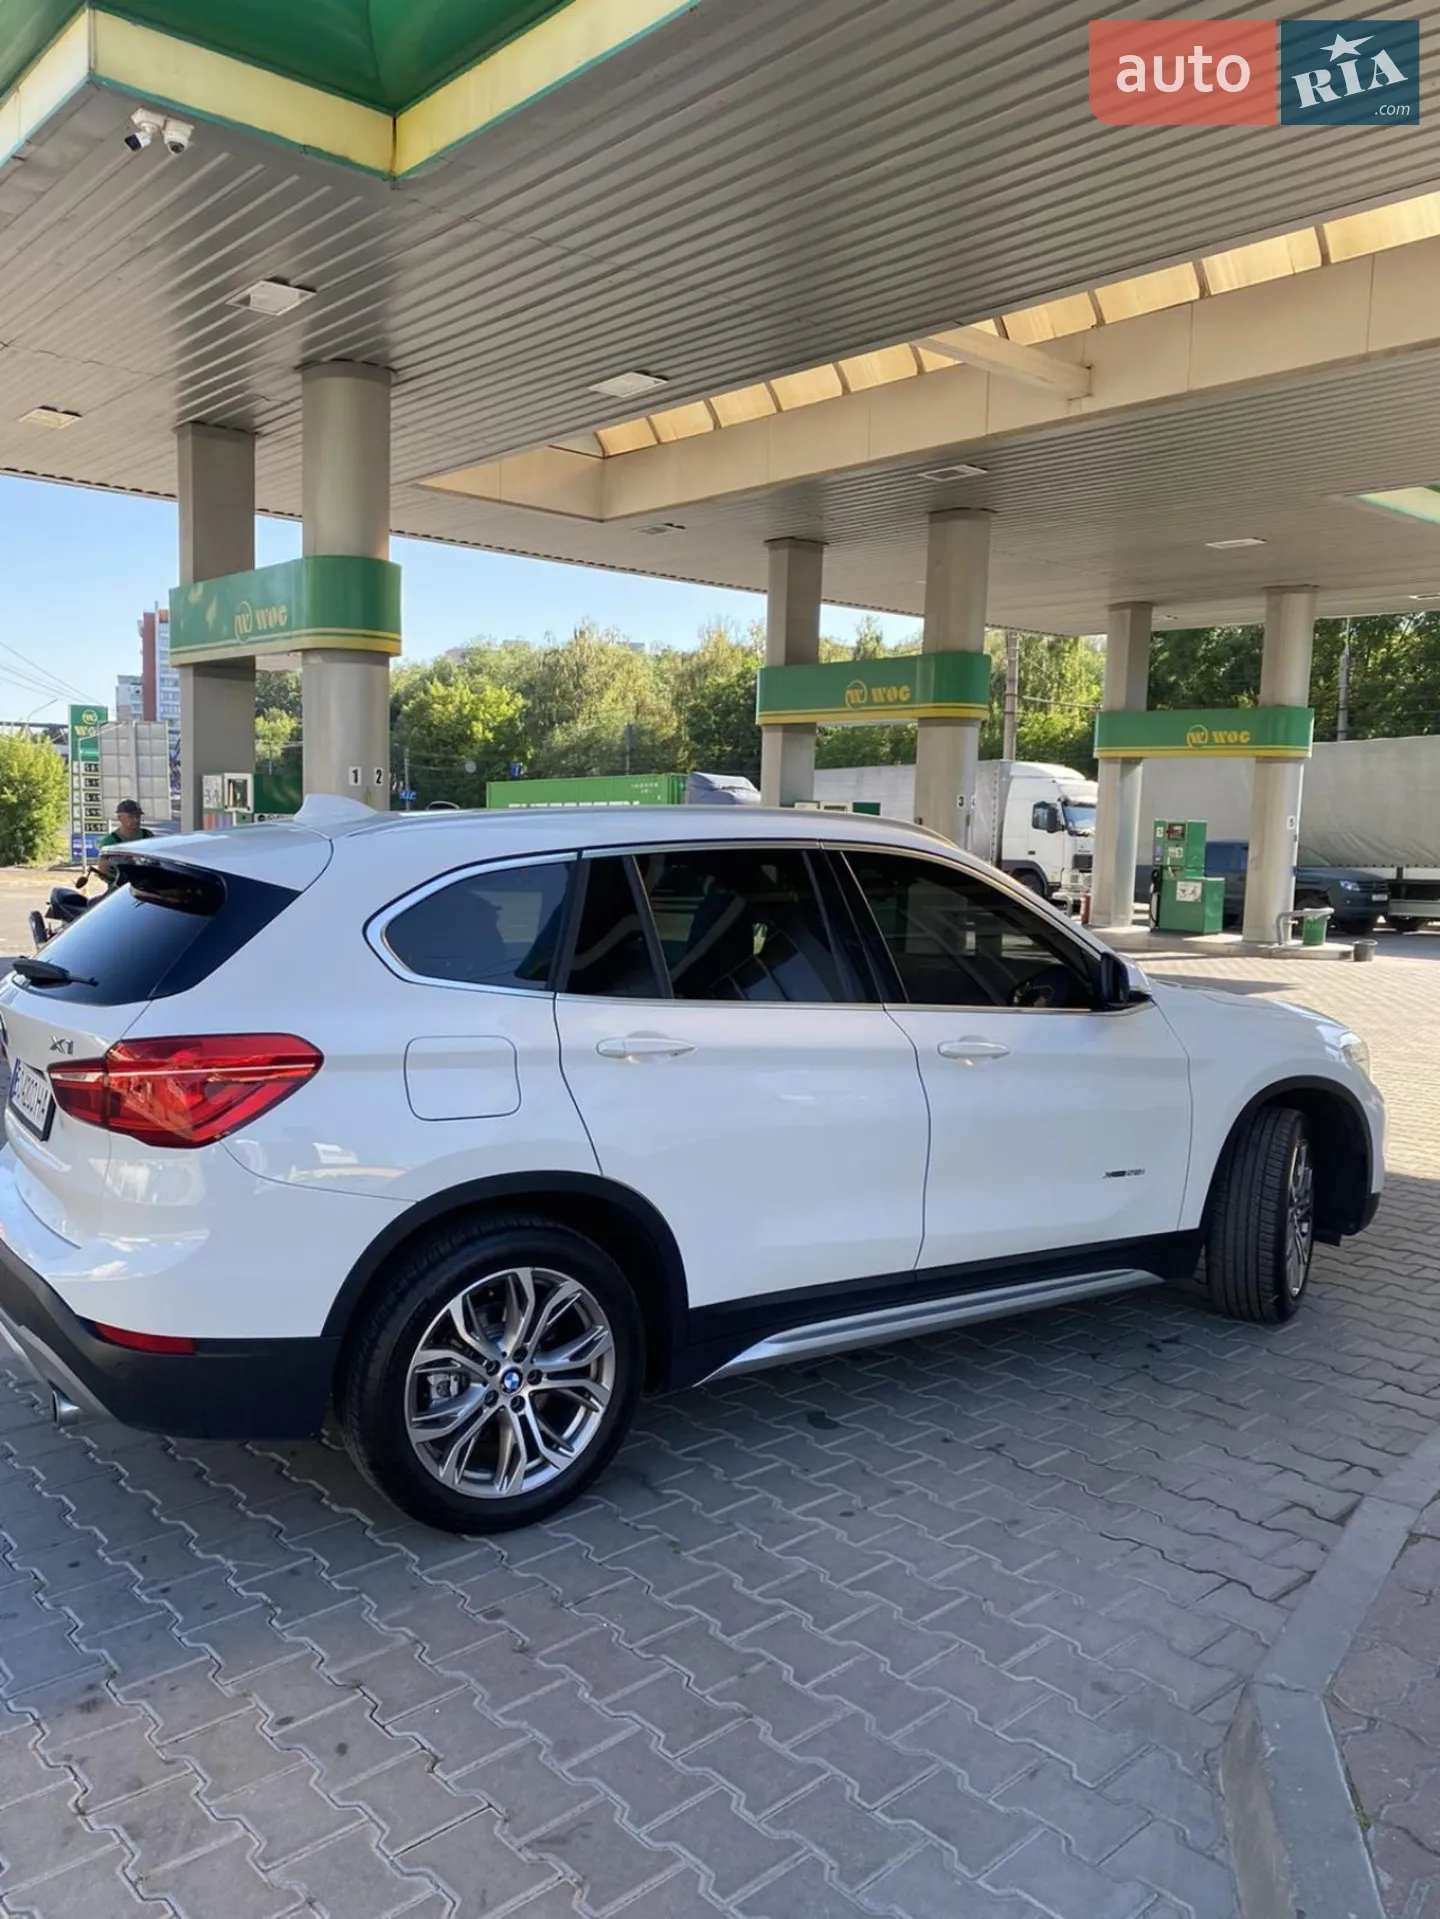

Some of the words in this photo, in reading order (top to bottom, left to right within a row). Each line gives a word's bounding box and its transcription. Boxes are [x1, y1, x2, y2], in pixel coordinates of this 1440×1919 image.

[871, 684, 911, 703] WOG
[1212, 730, 1251, 744] WOG
[351, 769, 359, 784] 1
[376, 768, 382, 784] 2
[958, 795, 965, 807] 3
[49, 1036, 74, 1055] X1
